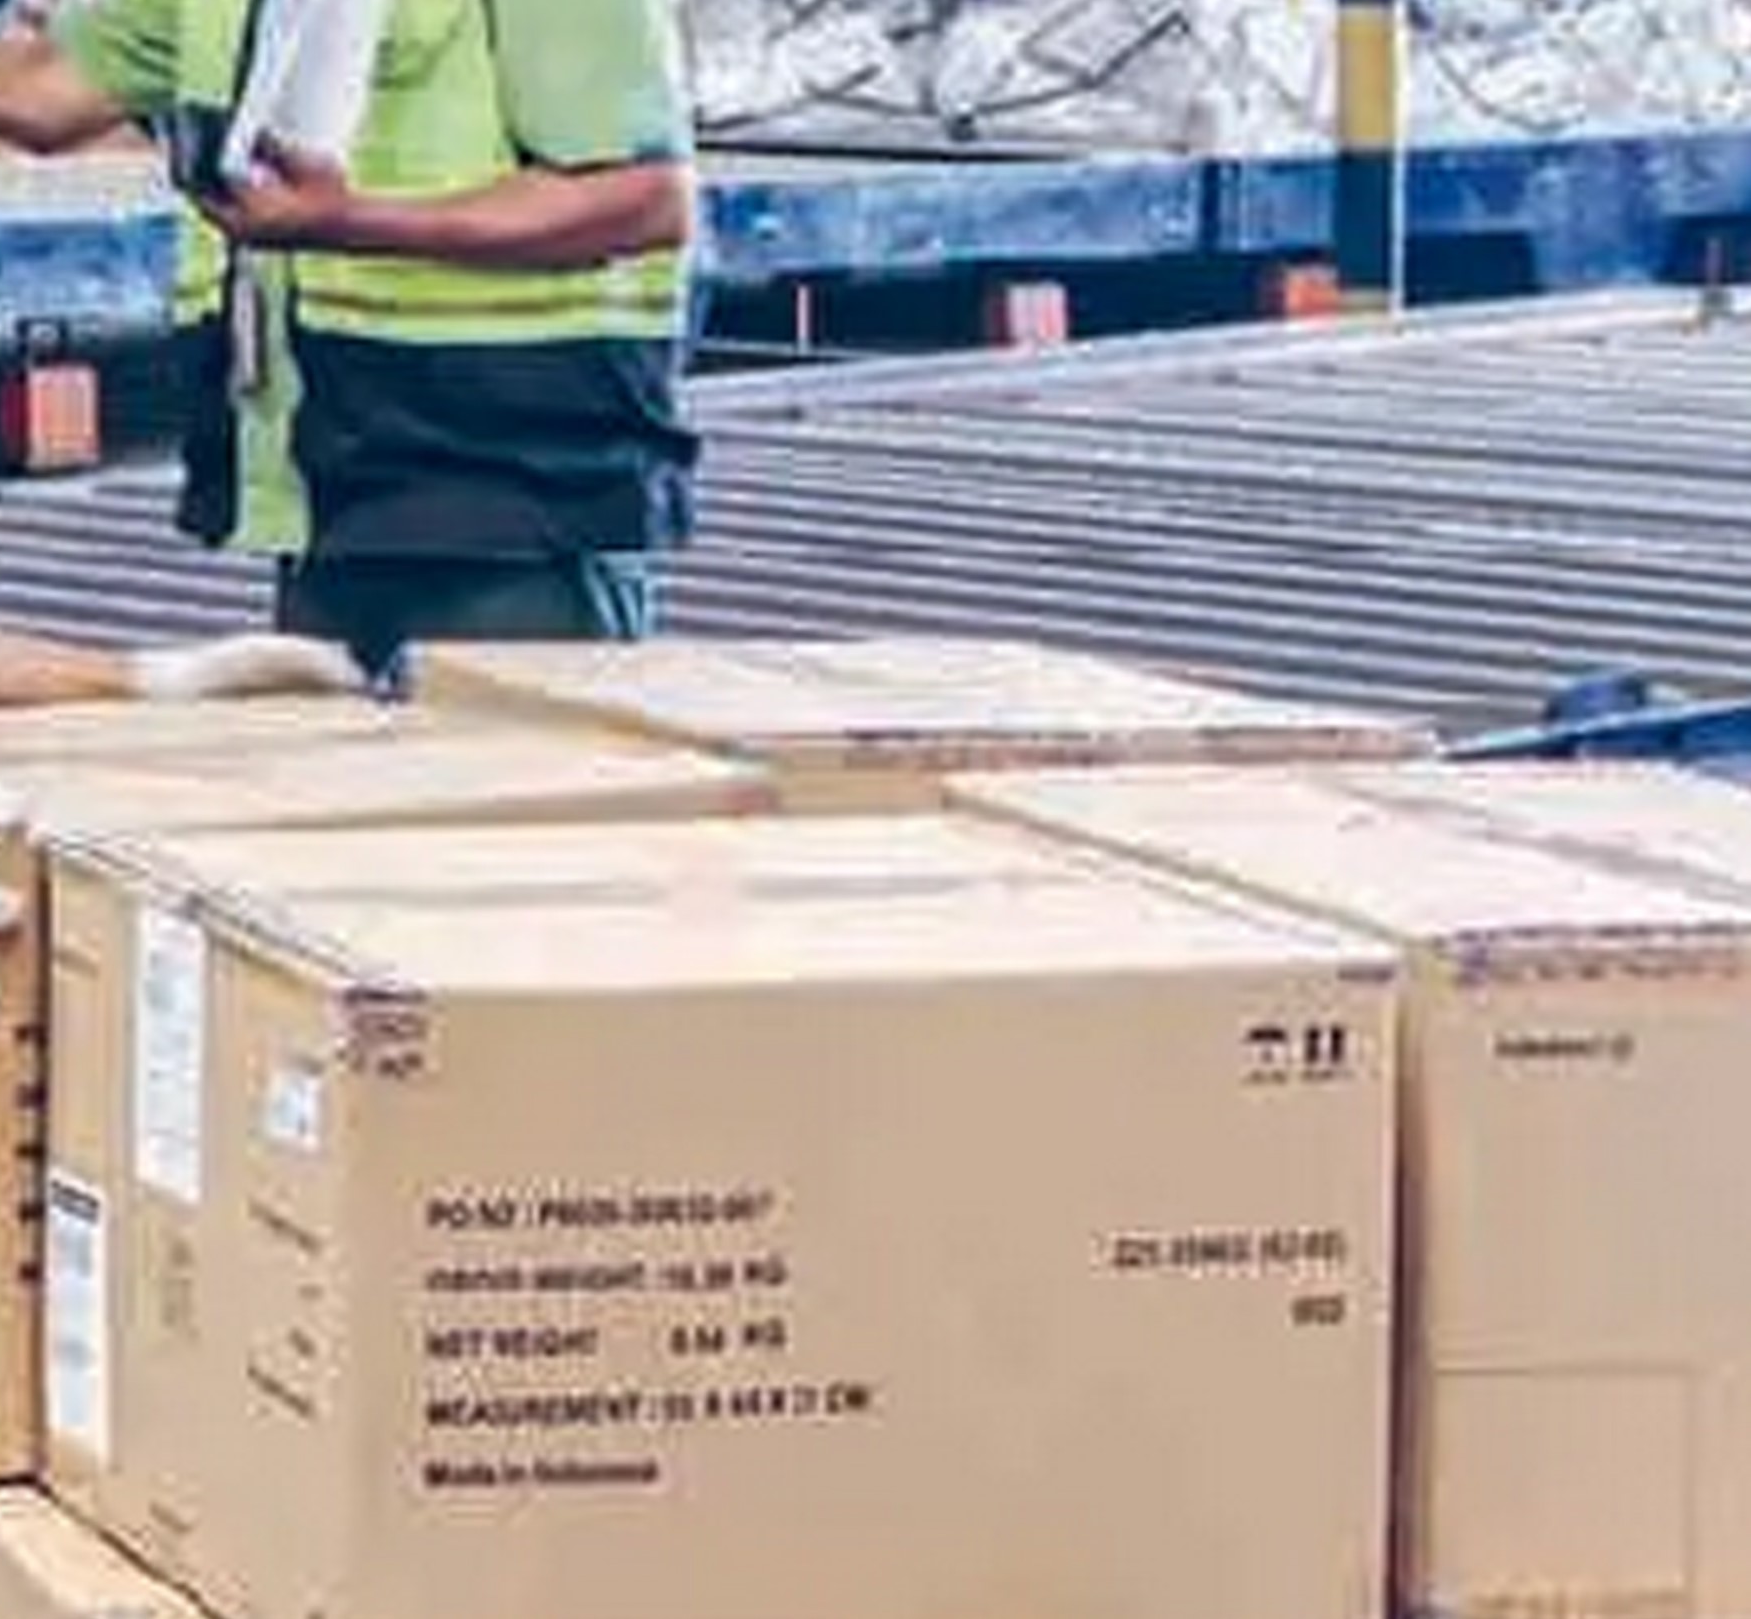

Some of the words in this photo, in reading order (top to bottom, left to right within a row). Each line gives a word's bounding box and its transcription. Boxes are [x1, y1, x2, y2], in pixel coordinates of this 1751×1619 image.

[743, 1254, 788, 1286] KG
[426, 1326, 483, 1359] NET
[493, 1326, 598, 1358] WEIGHT
[743, 1318, 787, 1350] KG
[426, 1392, 642, 1426] MEASUREMENT
[425, 1461, 496, 1487] Made
[502, 1462, 526, 1486] in
